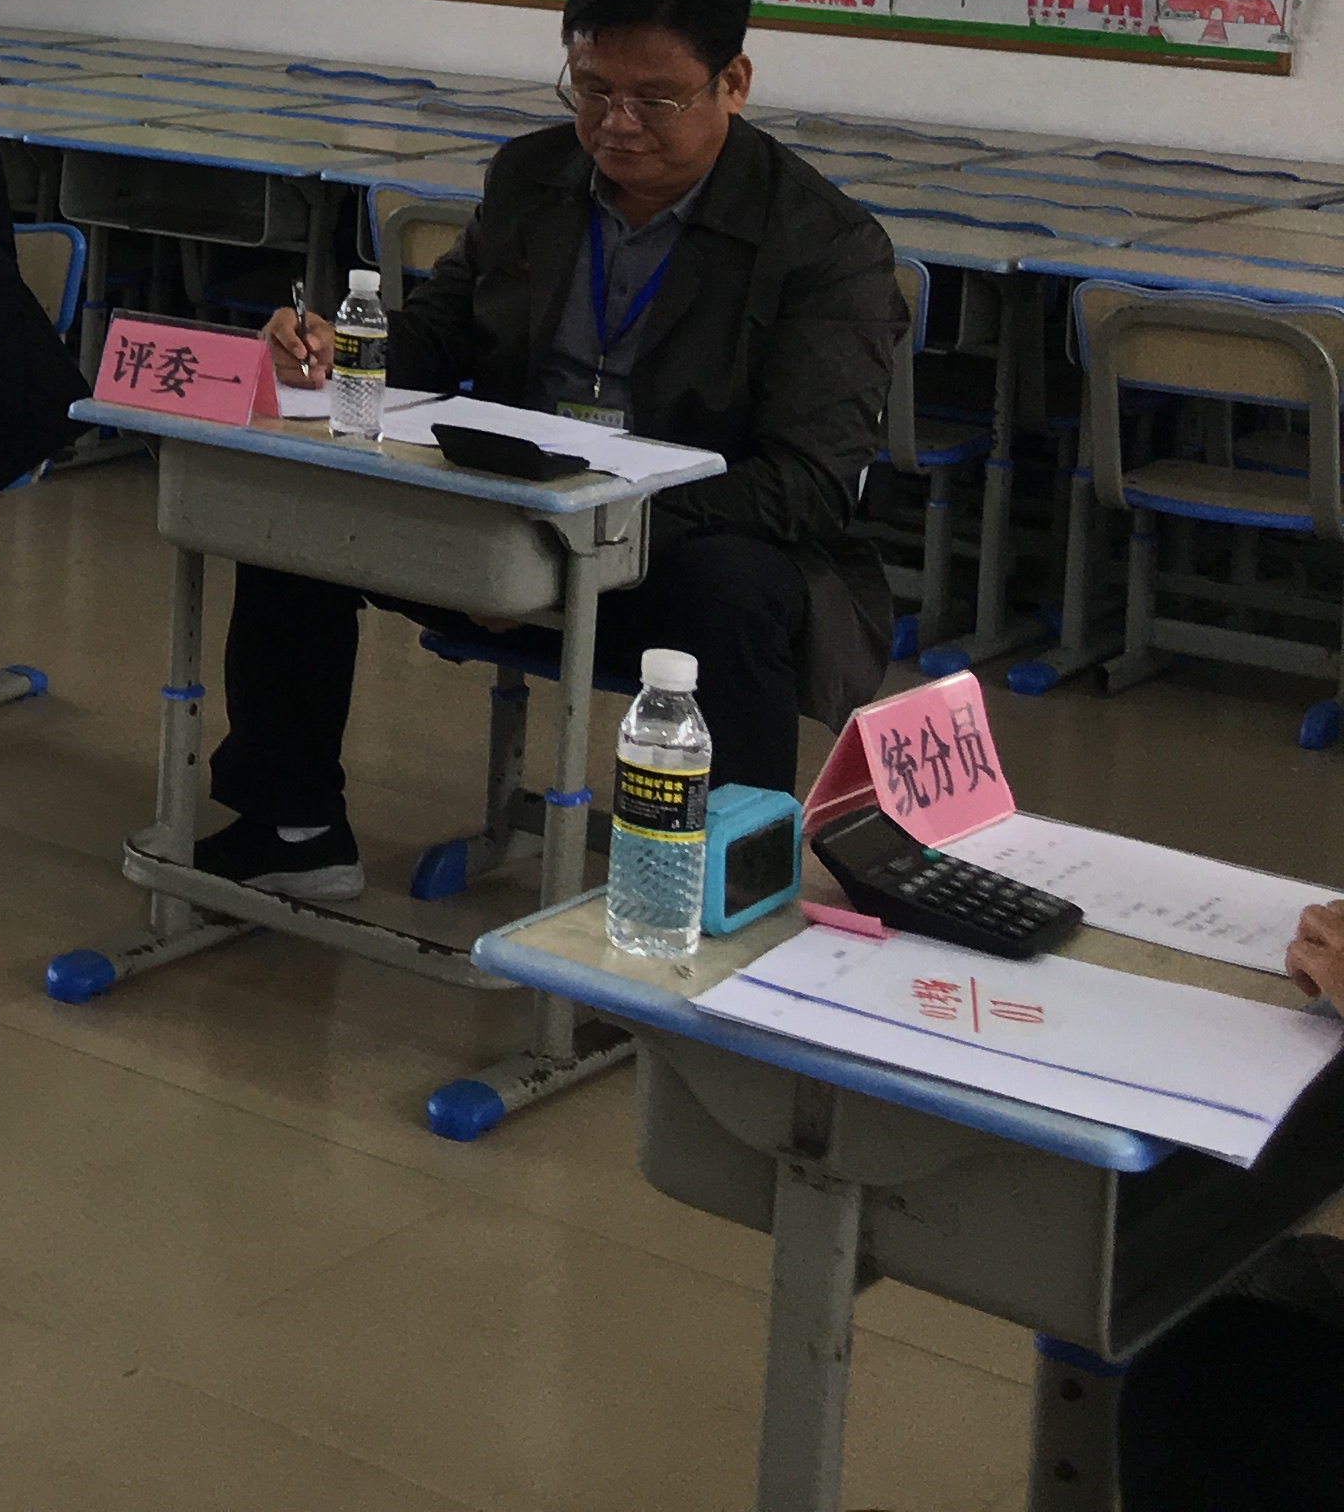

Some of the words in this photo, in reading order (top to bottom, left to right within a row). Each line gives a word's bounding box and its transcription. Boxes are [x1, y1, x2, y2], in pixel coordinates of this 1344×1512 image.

[113, 335, 242, 399] 评委一
[879, 701, 997, 816] 统分员
